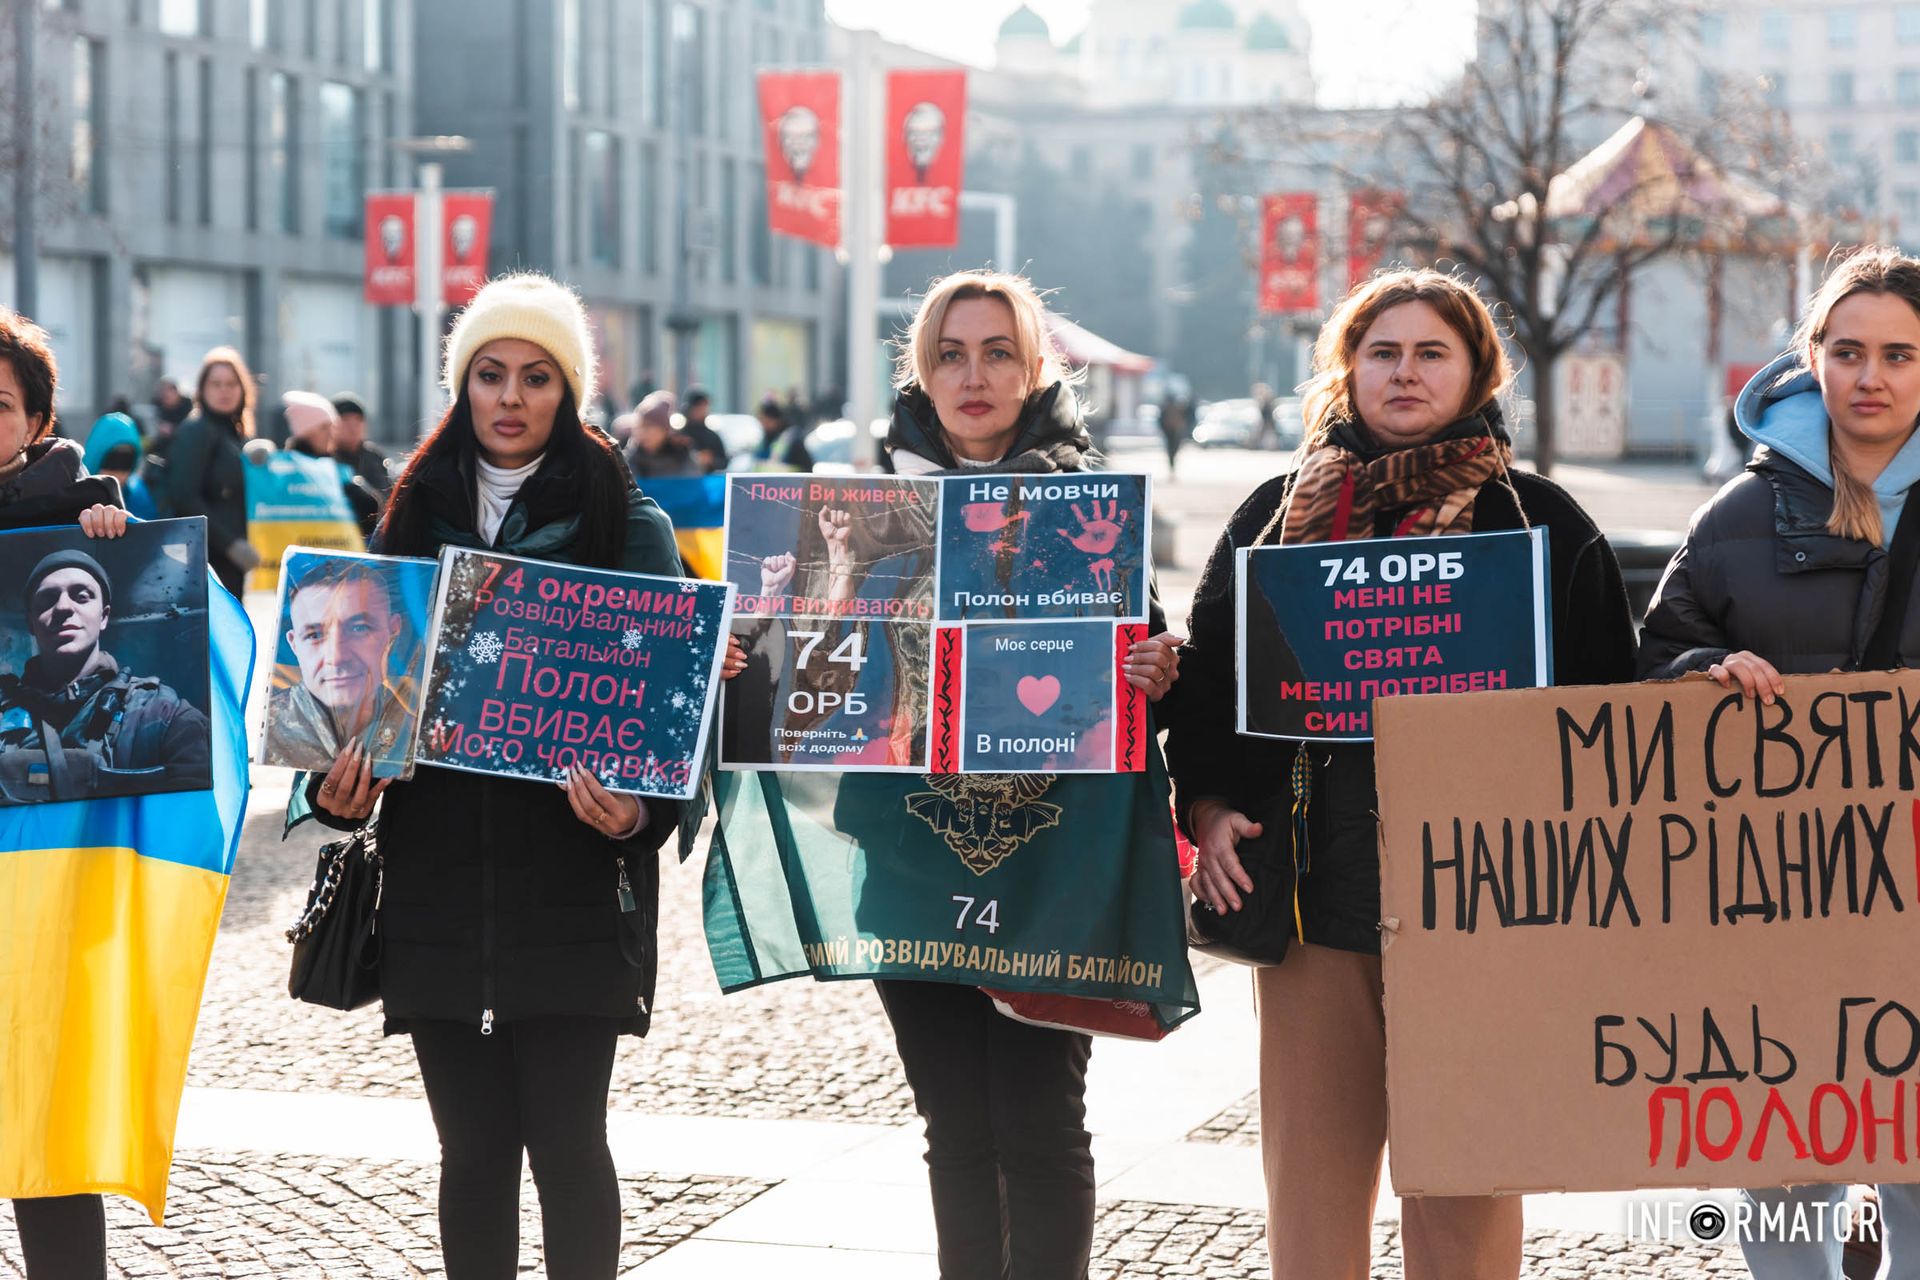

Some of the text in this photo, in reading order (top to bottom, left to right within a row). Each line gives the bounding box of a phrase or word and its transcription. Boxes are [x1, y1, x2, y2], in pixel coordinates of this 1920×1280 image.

[751, 483, 919, 504] Поки Ви живете
[969, 482, 1120, 501] Не мовчи
[1320, 552, 1464, 587] 74 ОРБ
[481, 561, 697, 617] 74 окремий
[954, 589, 1123, 606] Полон вбиває
[1334, 584, 1452, 610] МЕНІ НЕ
[474, 589, 693, 640] Розвідувальний
[792, 597, 929, 616] виживають
[1325, 613, 1461, 641] ПОТРІБНІ
[504, 627, 651, 668] Батальйон
[786, 631, 868, 671] 74
[995, 638, 1074, 653] Моє серце
[1344, 645, 1443, 671] СВЯТА
[1281, 670, 1507, 701] МЕНІ ПОТРІБЕН
[788, 692, 868, 715] ОРБ
[479, 699, 645, 751] ВБИВАЄ
[774, 727, 847, 740] Поверніть
[1305, 712, 1368, 732] СИН
[431, 718, 691, 784] Мого чоловіка
[778, 742, 864, 755] всіх додому
[976, 732, 1076, 753] В полоні
[1556, 701, 1676, 811] МИ
[1422, 812, 1640, 934] НАШИХ
[951, 895, 1000, 935] 74
[855, 937, 1061, 978] РОЗВІДУВАЛЬНИЙ
[1595, 1003, 1797, 1086] БУДЬ
[1648, 1078, 1920, 1169] ПОЛОН
